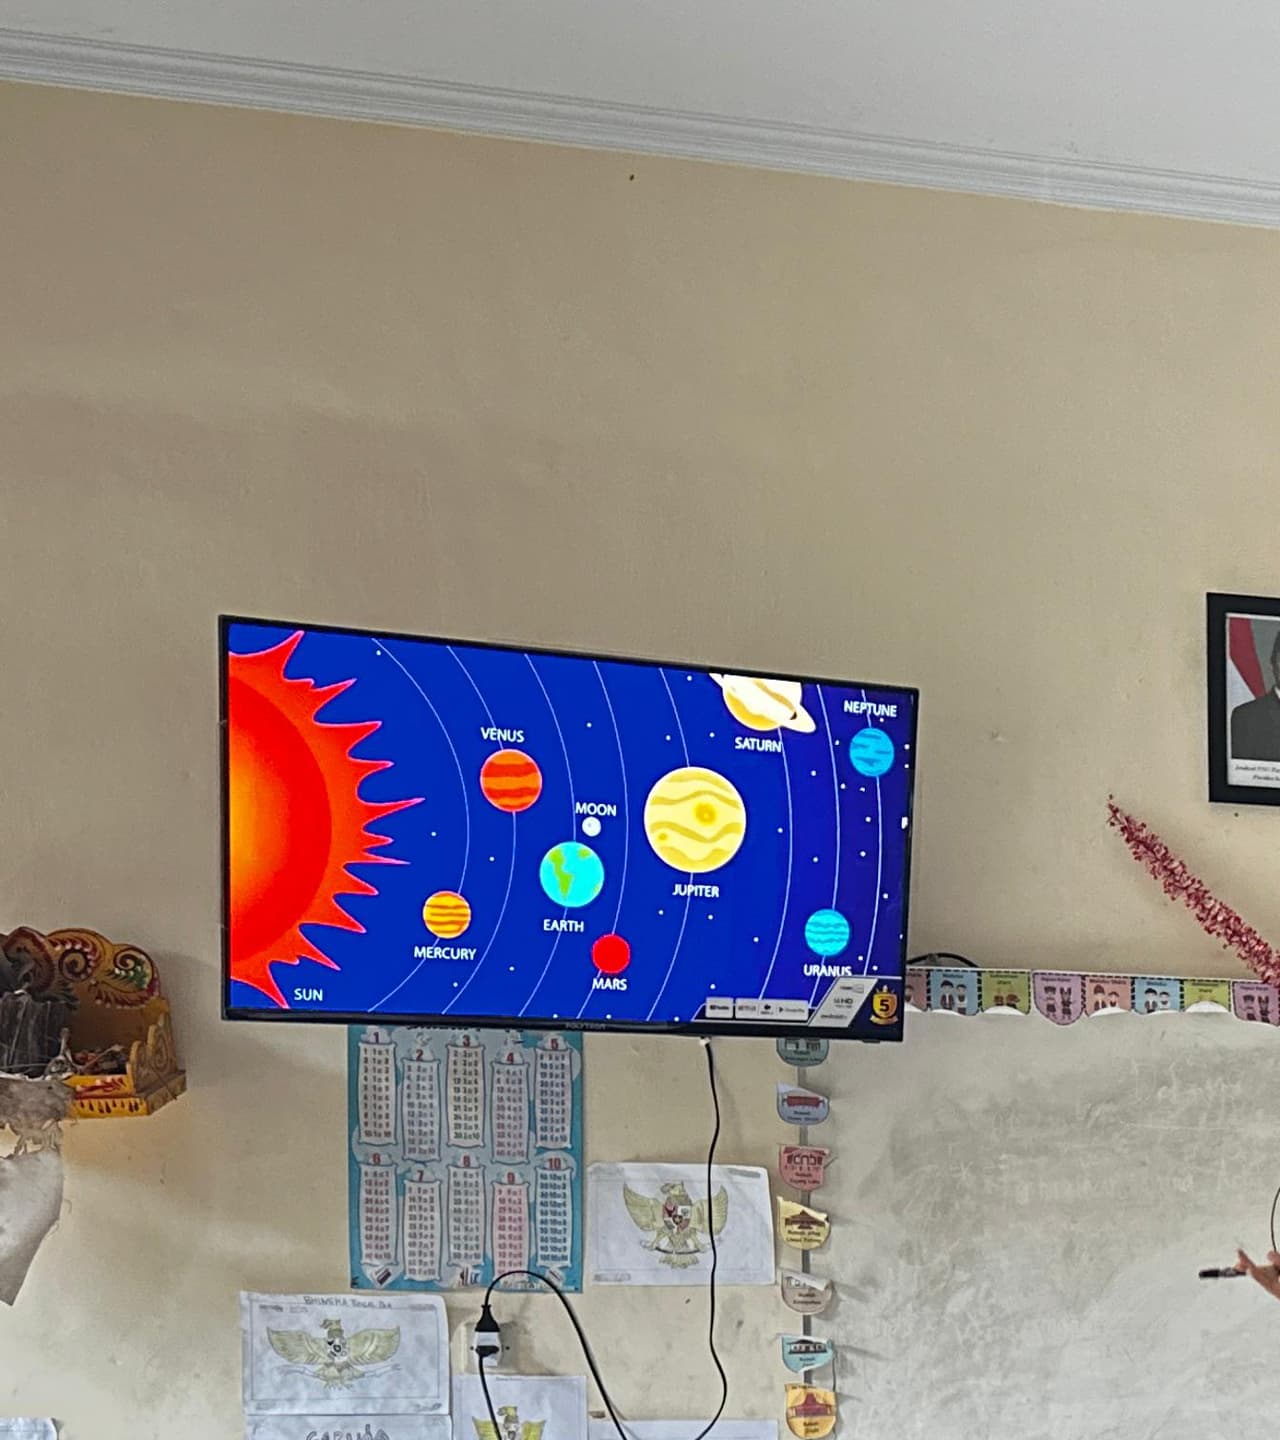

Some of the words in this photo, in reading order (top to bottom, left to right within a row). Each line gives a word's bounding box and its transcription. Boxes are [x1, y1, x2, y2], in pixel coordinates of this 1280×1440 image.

[843, 700, 897, 718] NEPTUNE
[480, 727, 524, 743] VENUS
[734, 737, 781, 753] SATURN
[575, 802, 616, 817] MOON
[672, 884, 719, 898] JUPITER
[542, 919, 584, 934] EARTH
[413, 945, 476, 961] MERCURY
[803, 964, 852, 977] URANUS
[591, 977, 627, 992] MARS
[293, 988, 323, 1002] SUN
